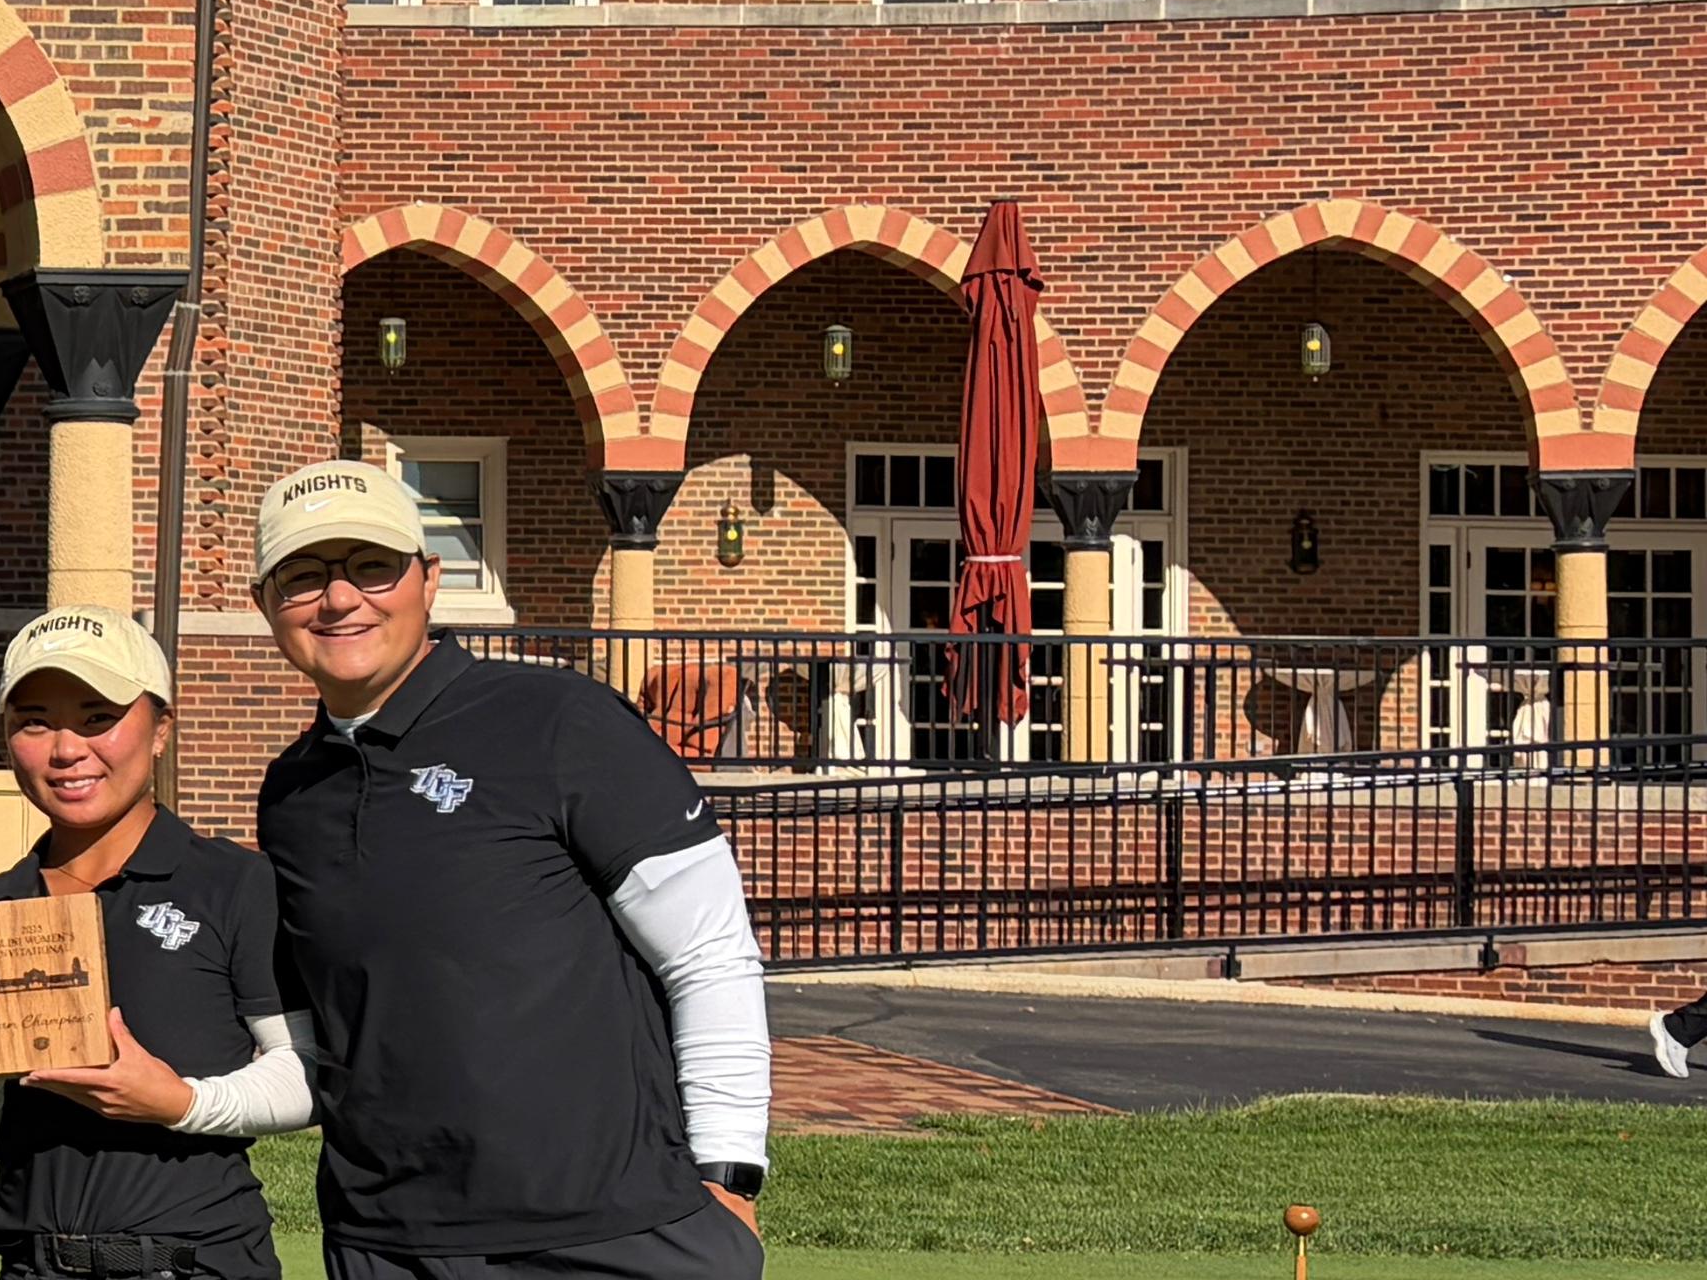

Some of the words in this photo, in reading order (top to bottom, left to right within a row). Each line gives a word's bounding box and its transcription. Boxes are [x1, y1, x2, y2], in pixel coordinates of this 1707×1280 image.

[282, 474, 367, 508] KNIGHTS
[26, 615, 104, 644] KNIGHTS
[410, 763, 474, 813] UCF
[136, 901, 200, 950] UCF
